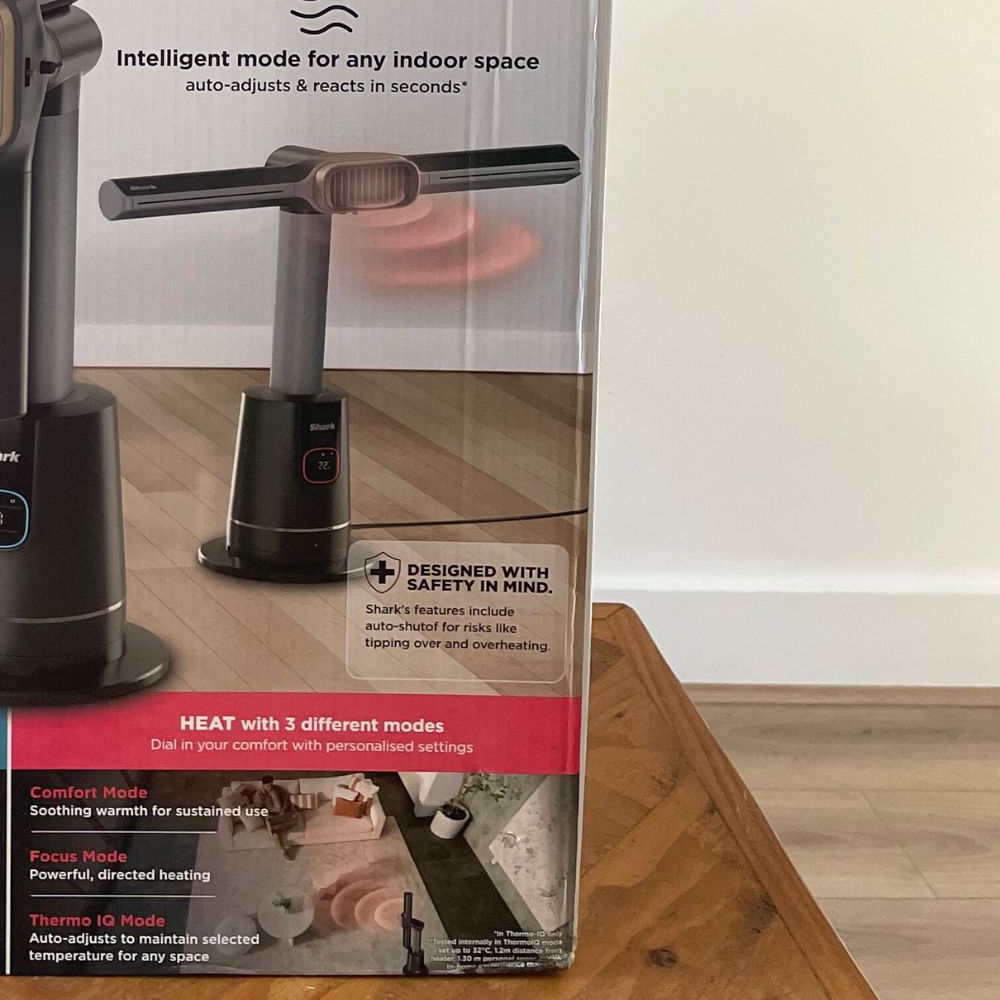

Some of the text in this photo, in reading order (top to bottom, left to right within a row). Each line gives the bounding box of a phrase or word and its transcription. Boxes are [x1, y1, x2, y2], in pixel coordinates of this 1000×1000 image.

[117, 49, 539, 73] Intelligent mode for any indoor space
[185, 78, 291, 95] auto-adjusts
[297, 80, 307, 92] &
[313, 80, 365, 93] reacts
[370, 80, 385, 93] in
[407, 564, 549, 578] DESIGNED WITH
[407, 579, 552, 593] SAFETY IN MIND.
[366, 604, 515, 617] Shark's features include
[442, 622, 460, 632] for
[463, 622, 492, 633] risks
[496, 623, 517, 633] like
[365, 638, 551, 653] tipping over and overheating.
[180, 716, 444, 733] HEAT with 3 different modes
[151, 739, 473, 756] Dial in your comfort with personalised settings
[30, 786, 148, 800] Comfort Mode
[30, 805, 268, 820] Soothing warmth for sustained use
[30, 851, 127, 863] Focus Mode
[30, 869, 211, 883] Powerful, directed heating
[30, 915, 165, 928] Thermo IQ Mode
[30, 933, 260, 947] Auto-adjusts to maintain selected
[30, 950, 209, 965] temperature for any space
